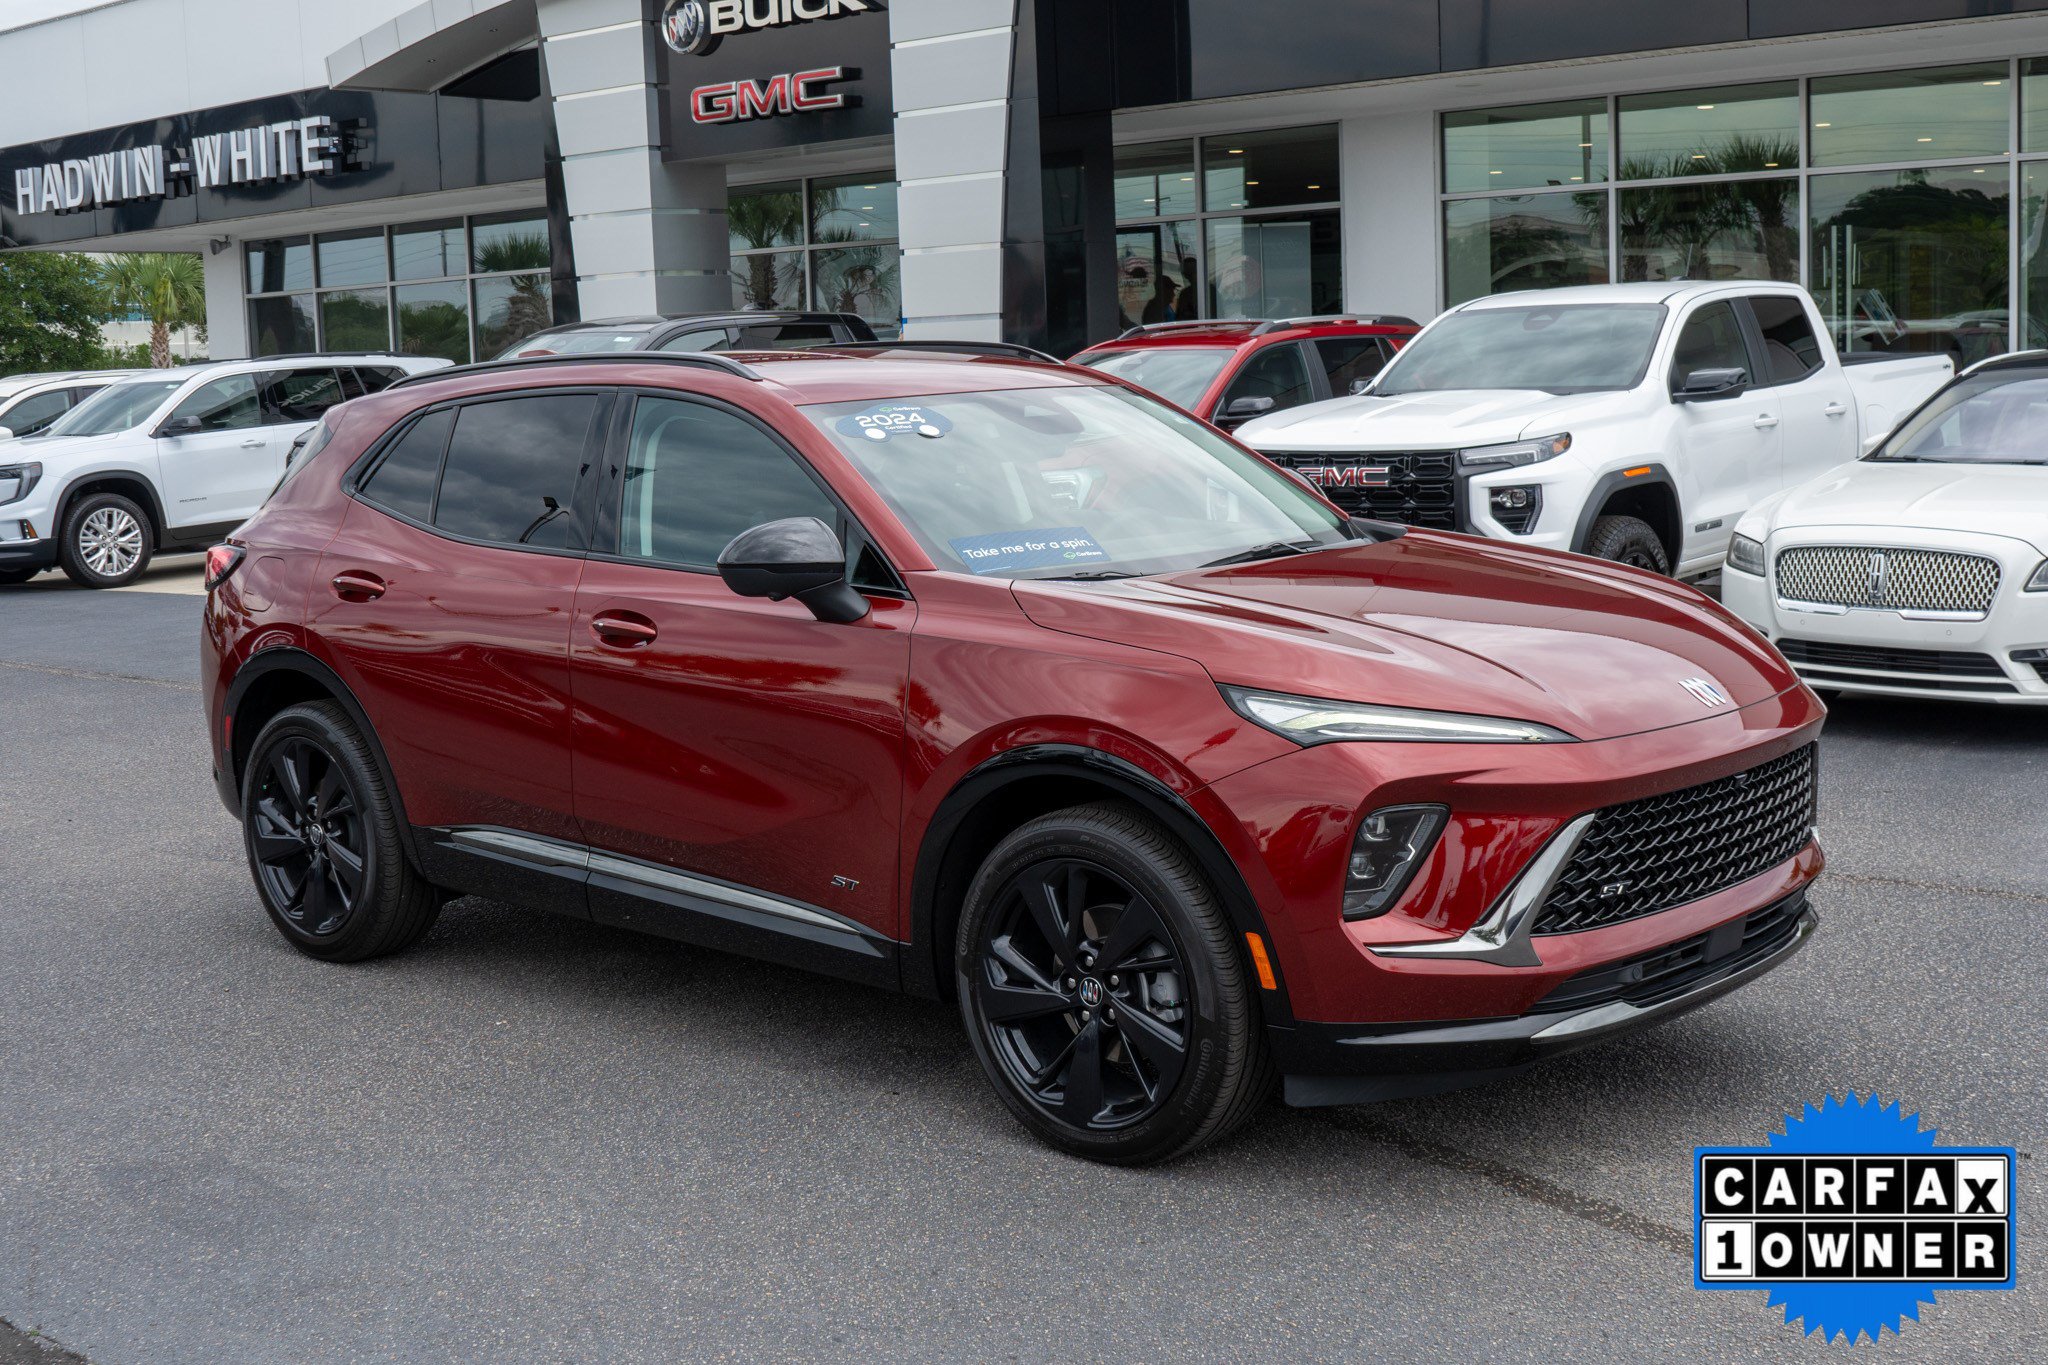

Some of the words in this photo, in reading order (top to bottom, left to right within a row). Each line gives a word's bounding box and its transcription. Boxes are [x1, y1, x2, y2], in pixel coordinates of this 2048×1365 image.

[691, 66, 844, 123] GMC
[15, 145, 164, 215] HADWIN
[192, 115, 334, 187] WHITE
[854, 413, 926, 428] 2024
[963, 548, 999, 559] Take
[1001, 544, 1024, 554] me
[1025, 541, 1046, 550] for
[1049, 541, 1060, 549] a
[1061, 538, 1094, 549] spin.
[831, 875, 860, 891] ST
